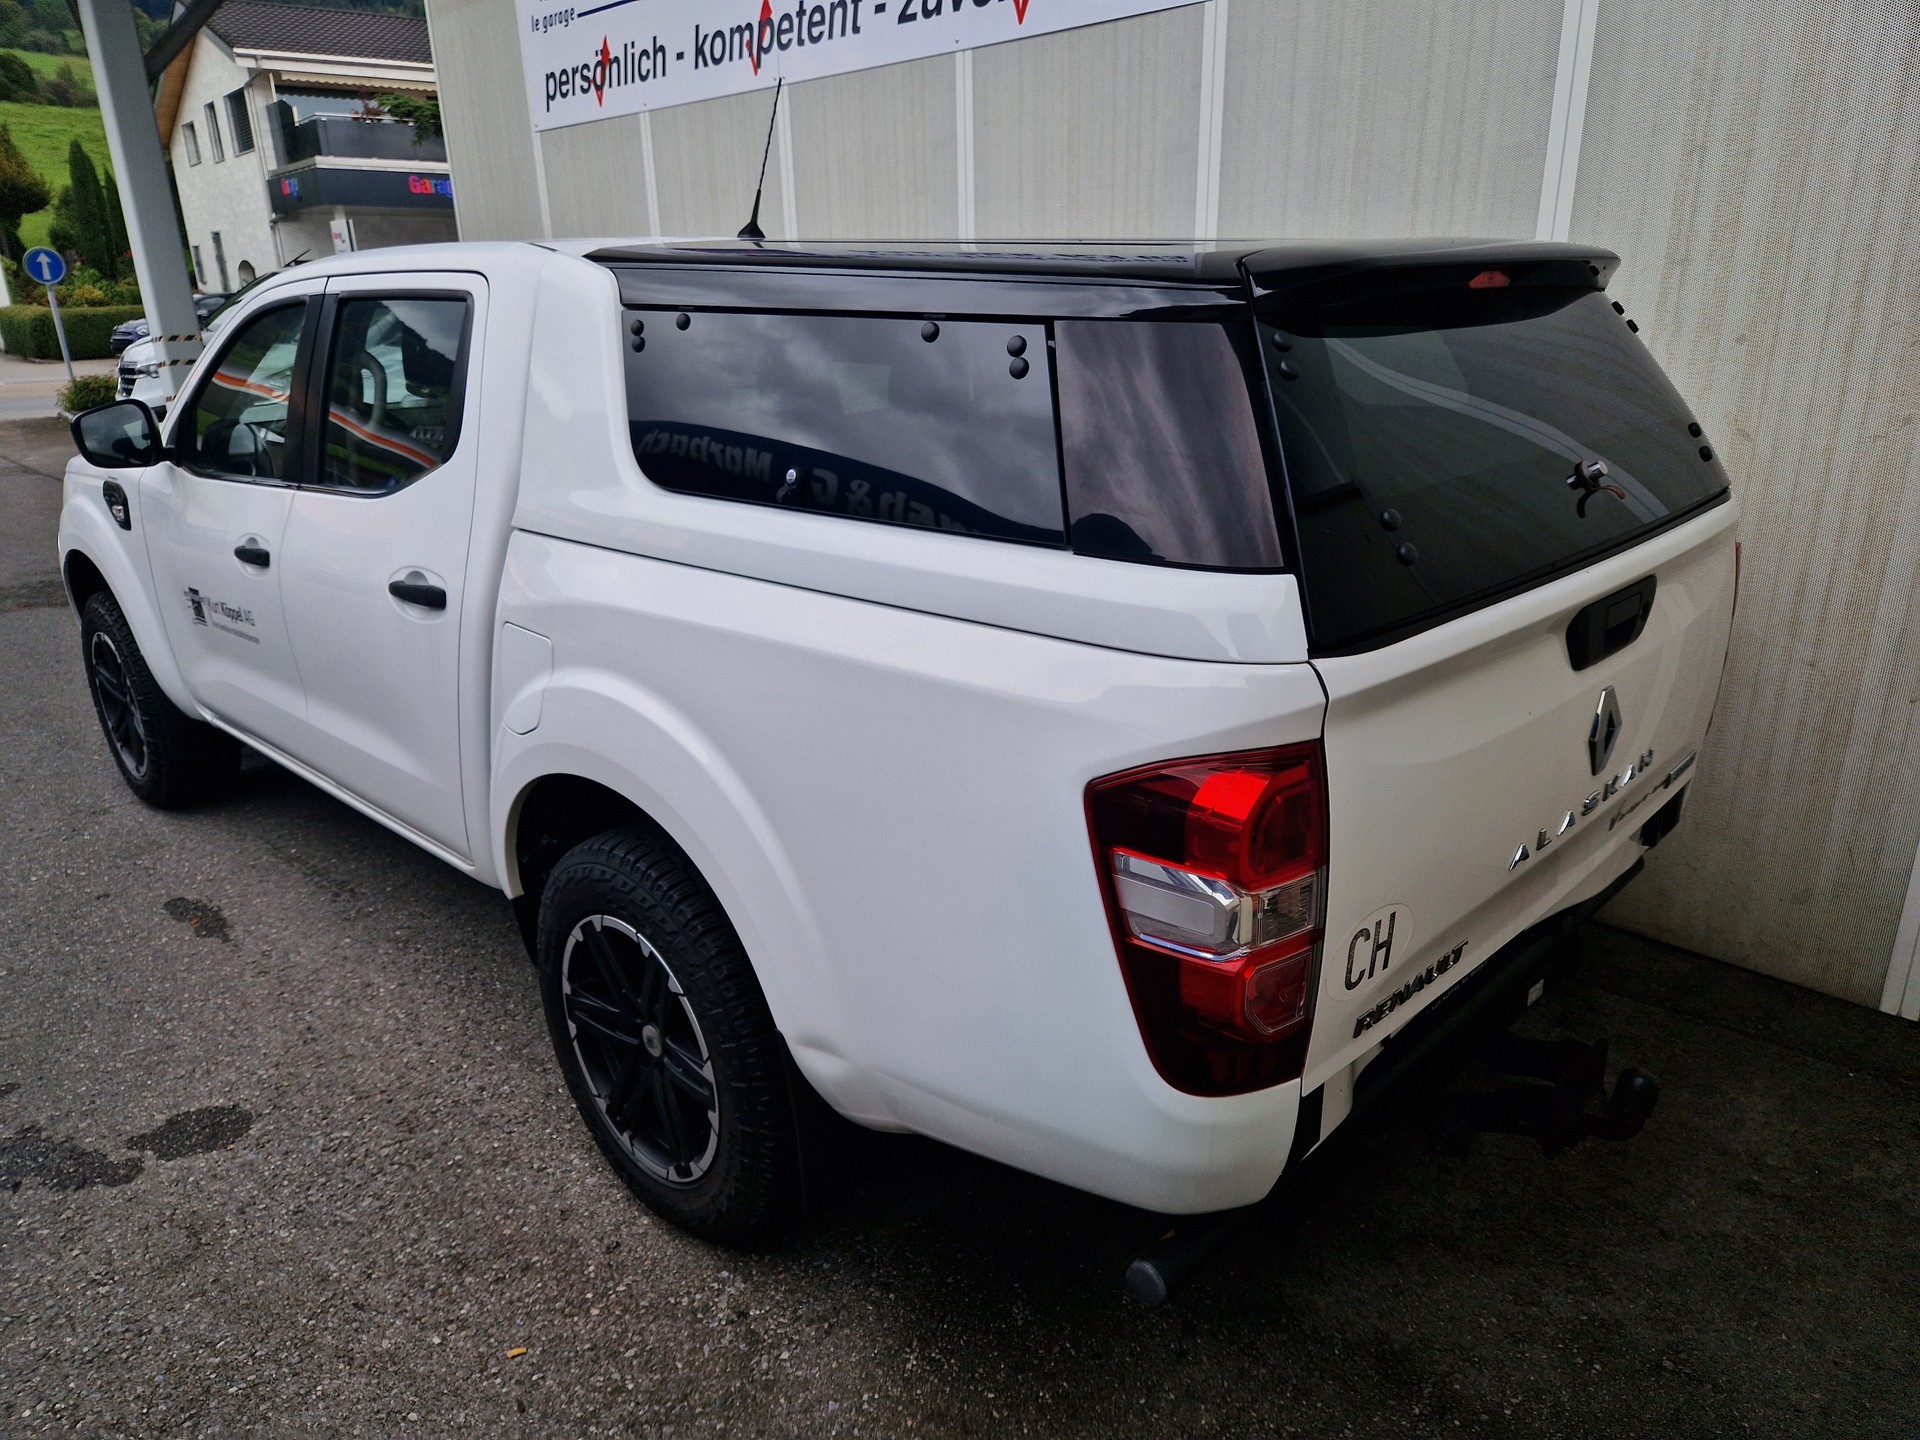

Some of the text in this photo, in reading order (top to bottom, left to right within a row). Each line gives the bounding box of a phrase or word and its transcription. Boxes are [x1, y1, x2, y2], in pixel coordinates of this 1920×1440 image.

[531, 7, 575, 34] le garage
[545, 36, 667, 112] persönlich
[694, 0, 863, 70] kompetent
[1508, 748, 1654, 871] ALASKAN
[1344, 911, 1397, 991] CH
[1352, 938, 1469, 1039] RENAULT
